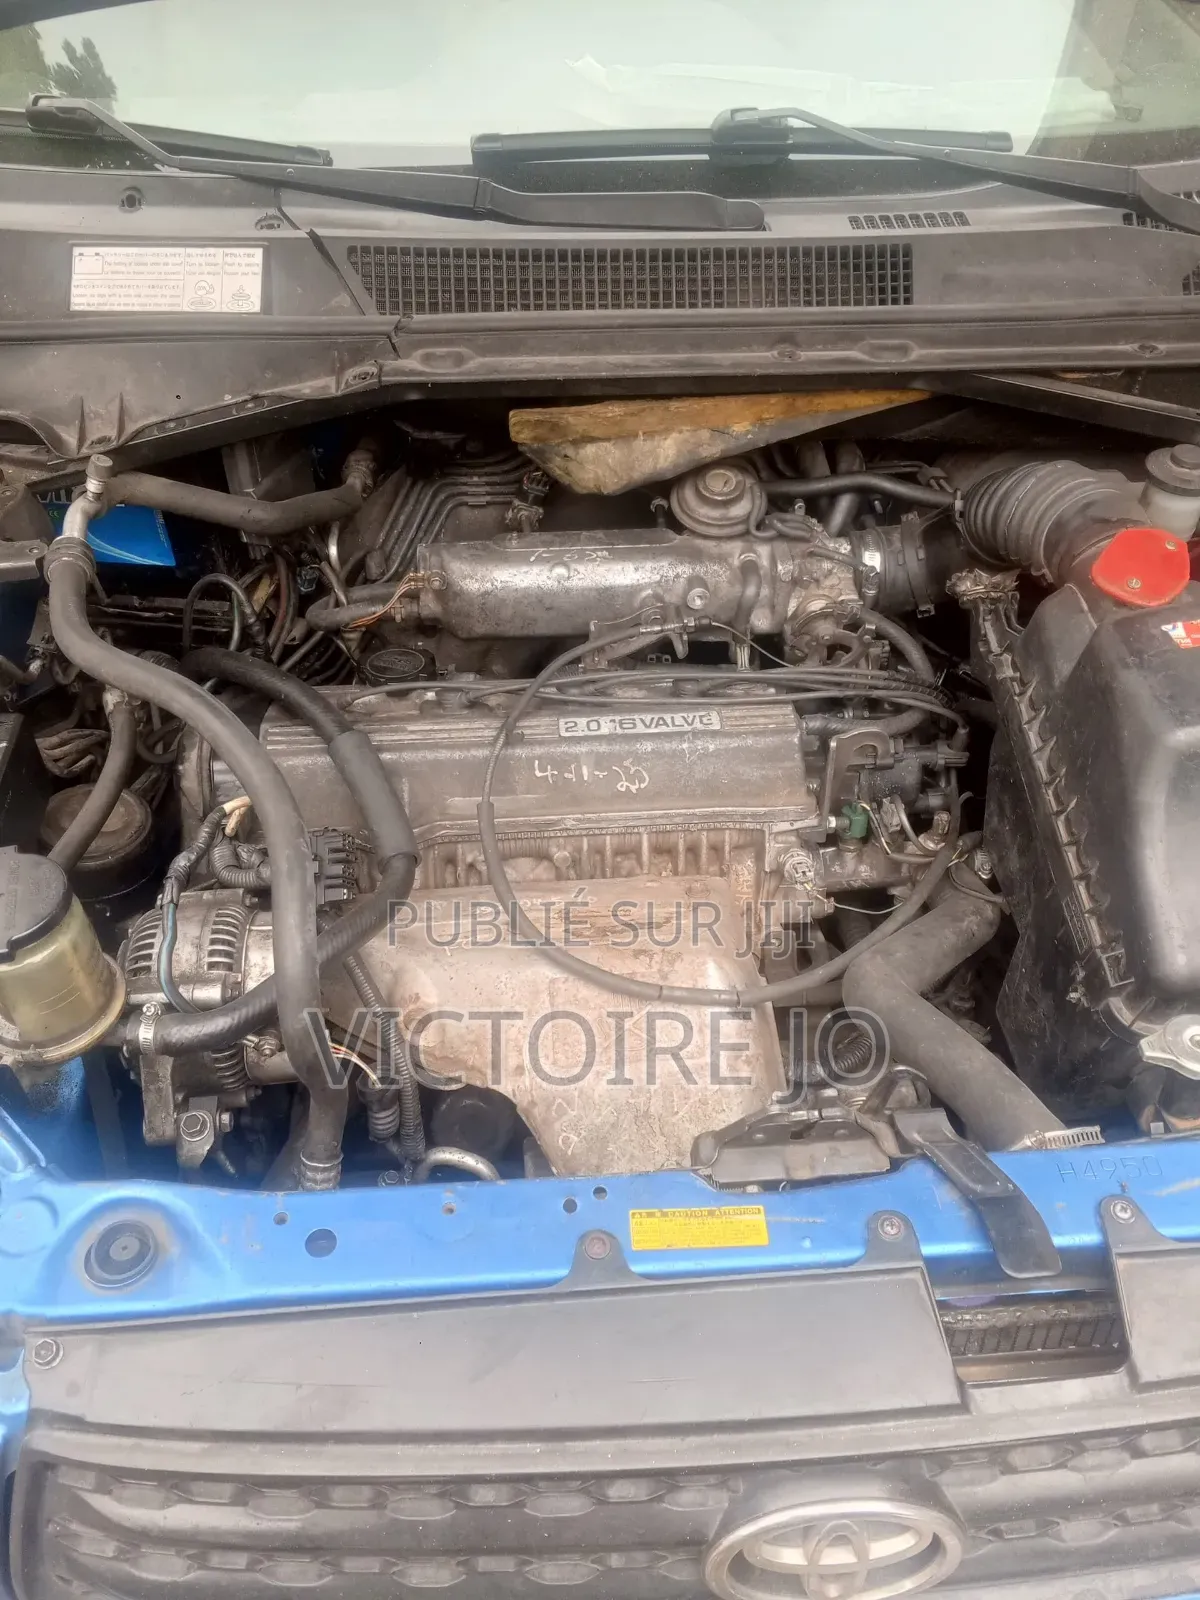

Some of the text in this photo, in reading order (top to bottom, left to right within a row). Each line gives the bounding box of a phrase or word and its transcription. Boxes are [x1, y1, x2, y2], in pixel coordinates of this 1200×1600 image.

[564, 719, 601, 733] 2.0
[1056, 1155, 1163, 1183] H4950
[668, 1210, 708, 1218] CAUTION
[715, 1207, 759, 1216] ATTENTION
